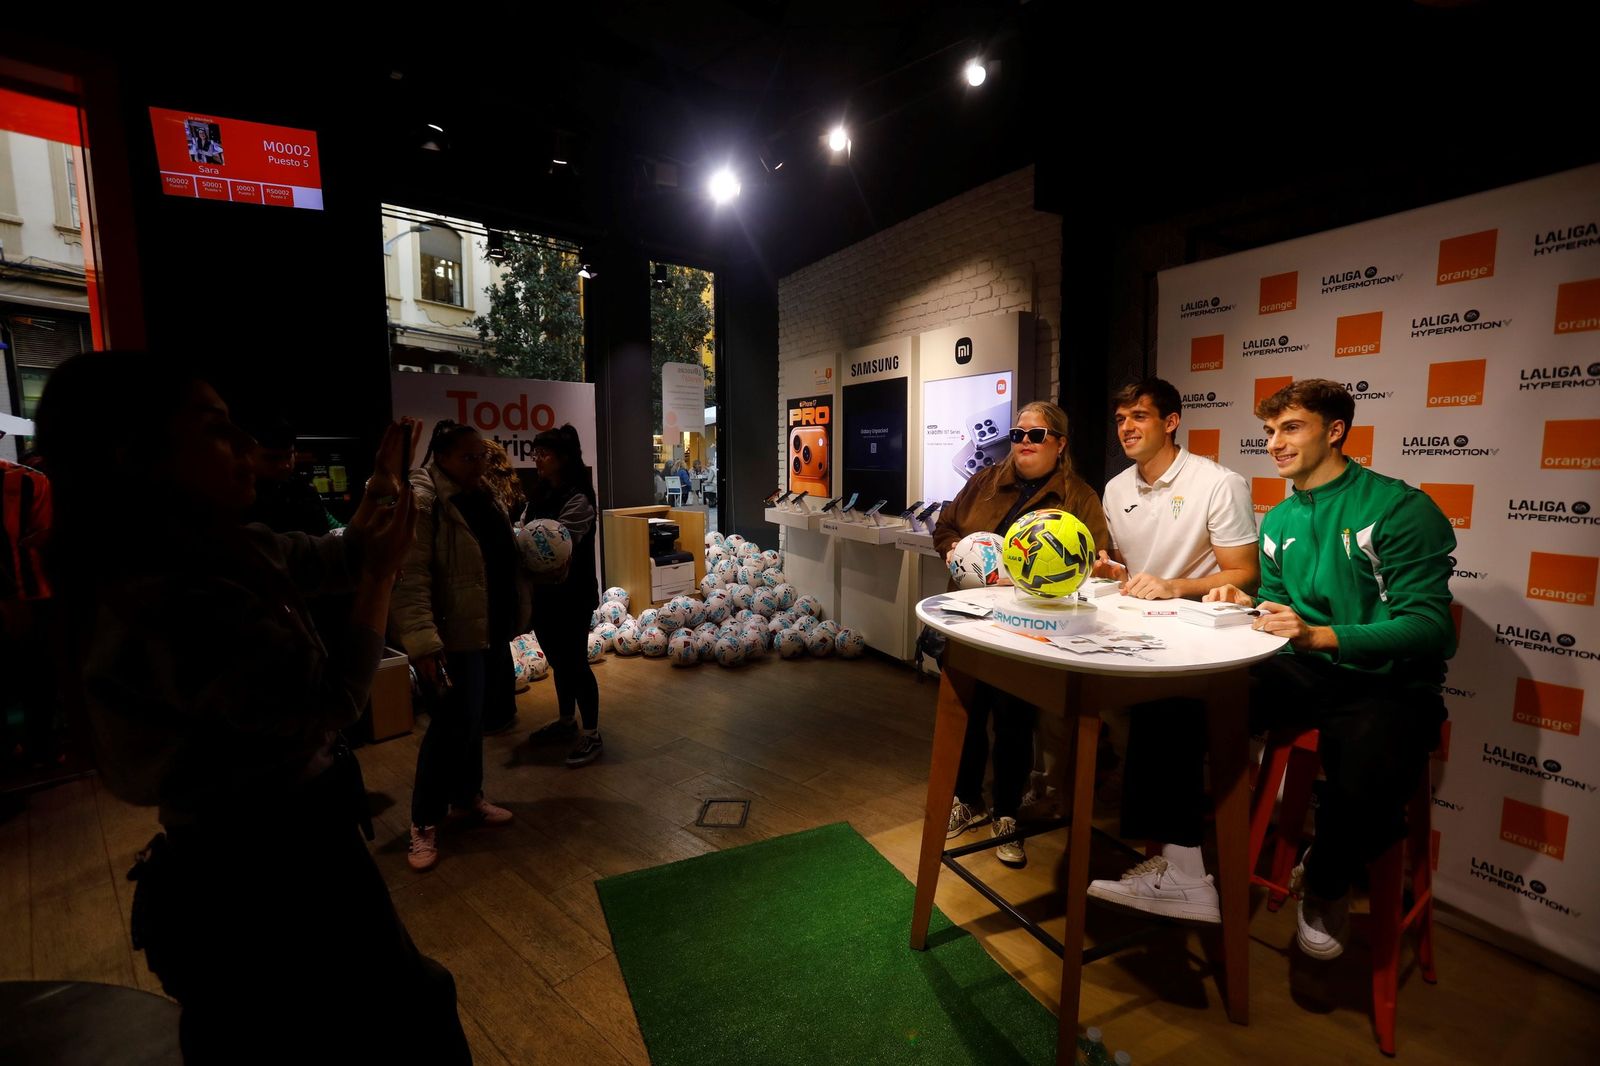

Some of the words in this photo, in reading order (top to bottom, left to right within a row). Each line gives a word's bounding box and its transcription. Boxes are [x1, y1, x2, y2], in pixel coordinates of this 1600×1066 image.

[263, 140, 311, 158] M0002
[268, 155, 300, 167] Puesto
[303, 159, 309, 168] 5
[198, 165, 219, 175] Sara
[1535, 223, 1598, 246] LALIGA
[1322, 270, 1361, 286] LALIGA
[1439, 266, 1488, 282] orange
[1180, 299, 1209, 312] LALIGA
[1260, 302, 1293, 313] orange
[1412, 313, 1459, 328] LALIGA
[1558, 317, 1600, 330] oran
[1242, 338, 1276, 350] LALIGA
[1337, 343, 1376, 354] orange
[851, 355, 899, 377] SAMSUNG
[1191, 361, 1220, 370] orange
[1520, 366, 1581, 381] LALIGA
[1429, 394, 1477, 405] orange
[446, 390, 556, 431] Todo
[789, 406, 830, 426] PRO
[1402, 436, 1450, 447] LALIGA
[1508, 499, 1567, 513] LALIGA
[1529, 586, 1587, 602] orange
[1496, 623, 1552, 643] LALIGA
[1515, 710, 1573, 730] orange
[1483, 743, 1538, 768] LALIGA
[1503, 830, 1558, 855] orange
[1471, 857, 1525, 886] LALIGA
